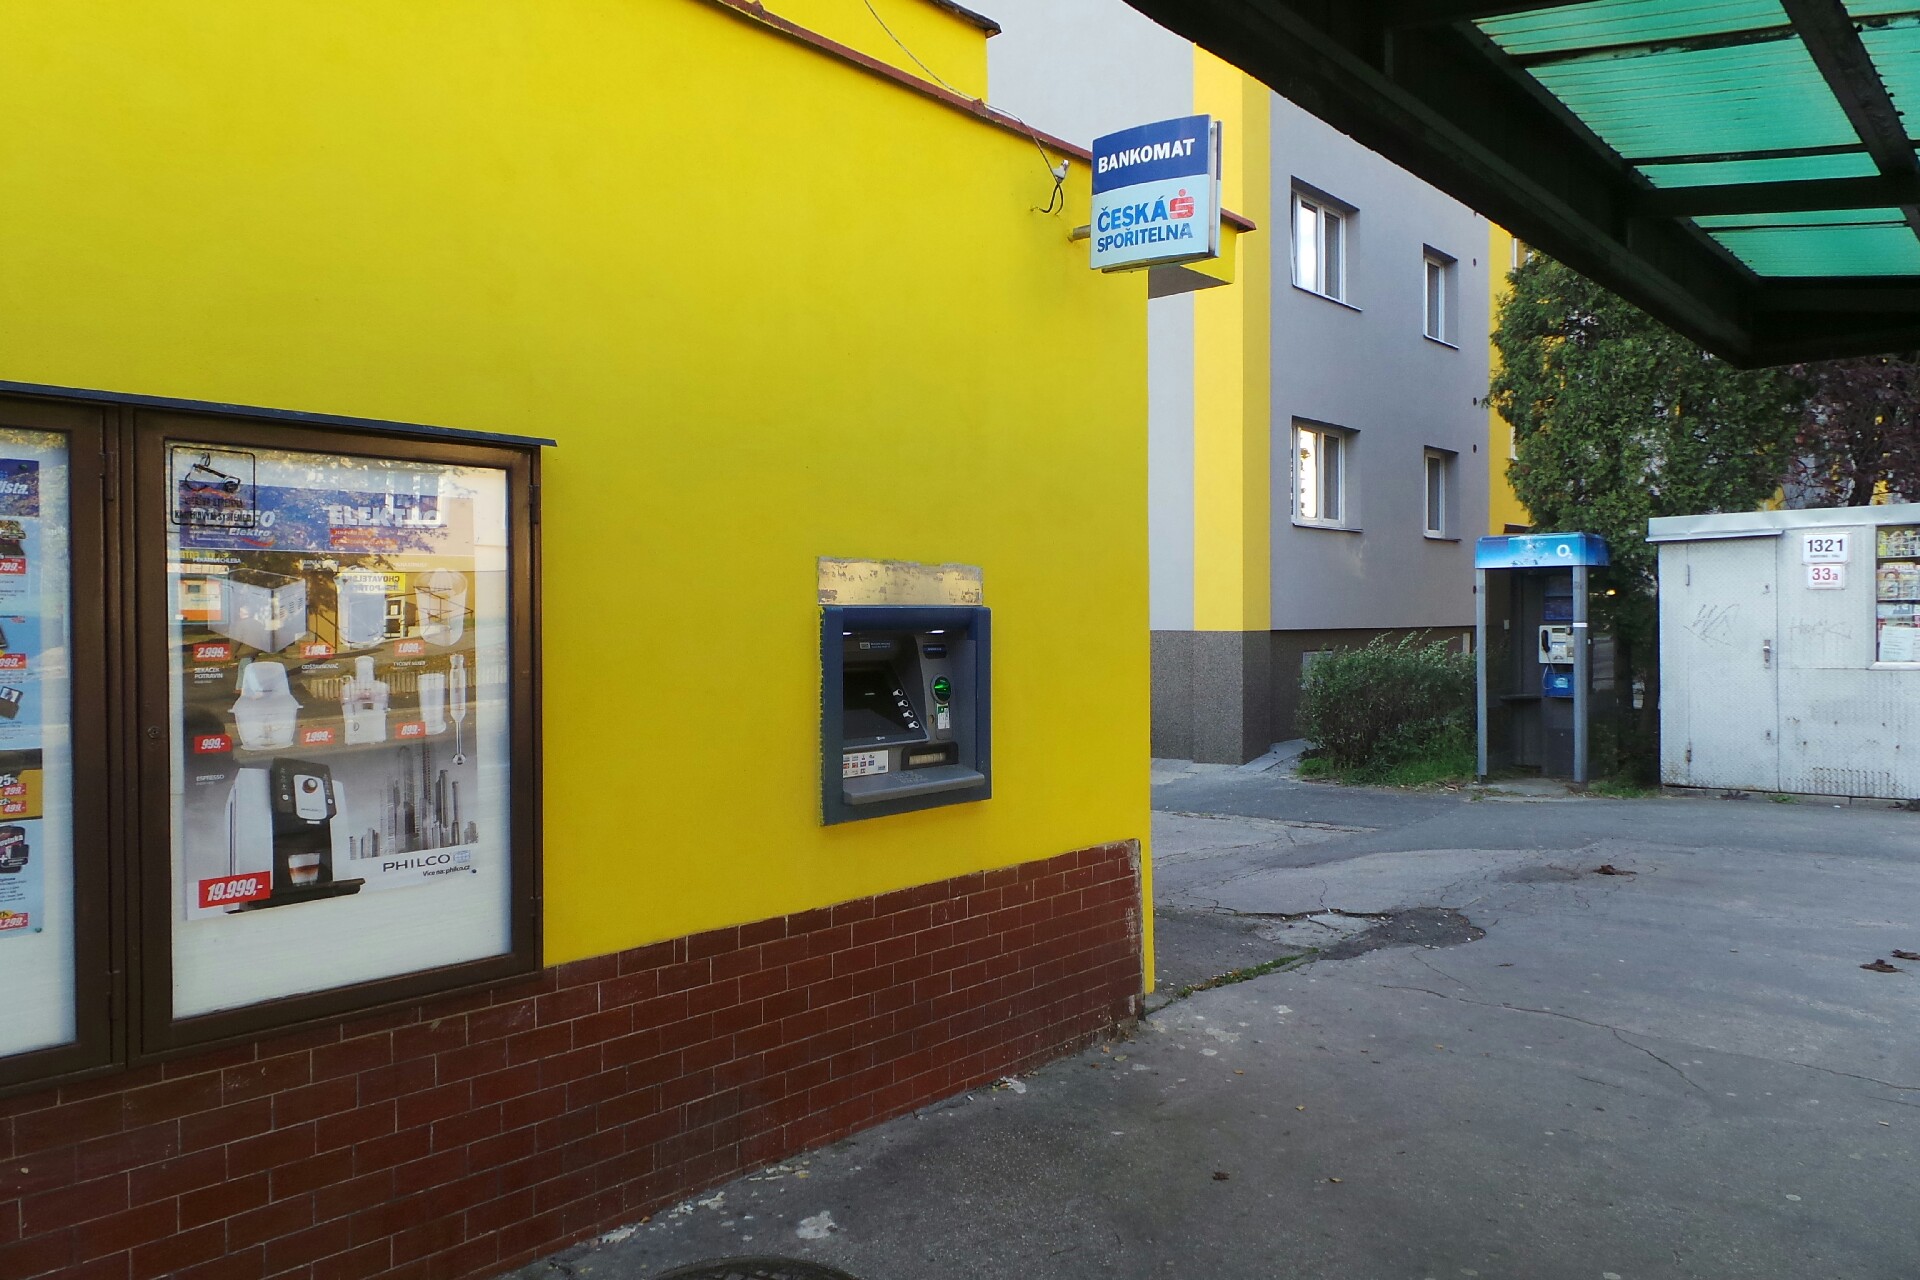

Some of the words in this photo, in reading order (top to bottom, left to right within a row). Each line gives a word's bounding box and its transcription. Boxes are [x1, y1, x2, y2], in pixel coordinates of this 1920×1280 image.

[1098, 138, 1195, 174] BANKOMAT
[1097, 195, 1168, 232] ČESKÁ
[1097, 222, 1193, 252] SPOŘITELNA
[229, 528, 271, 537] Elektro
[1807, 538, 1844, 552] 1321
[1812, 567, 1839, 580] 33a
[201, 738, 225, 749] 999,-
[383, 854, 450, 872] PHILCO
[207, 878, 264, 902] 19.999,-
